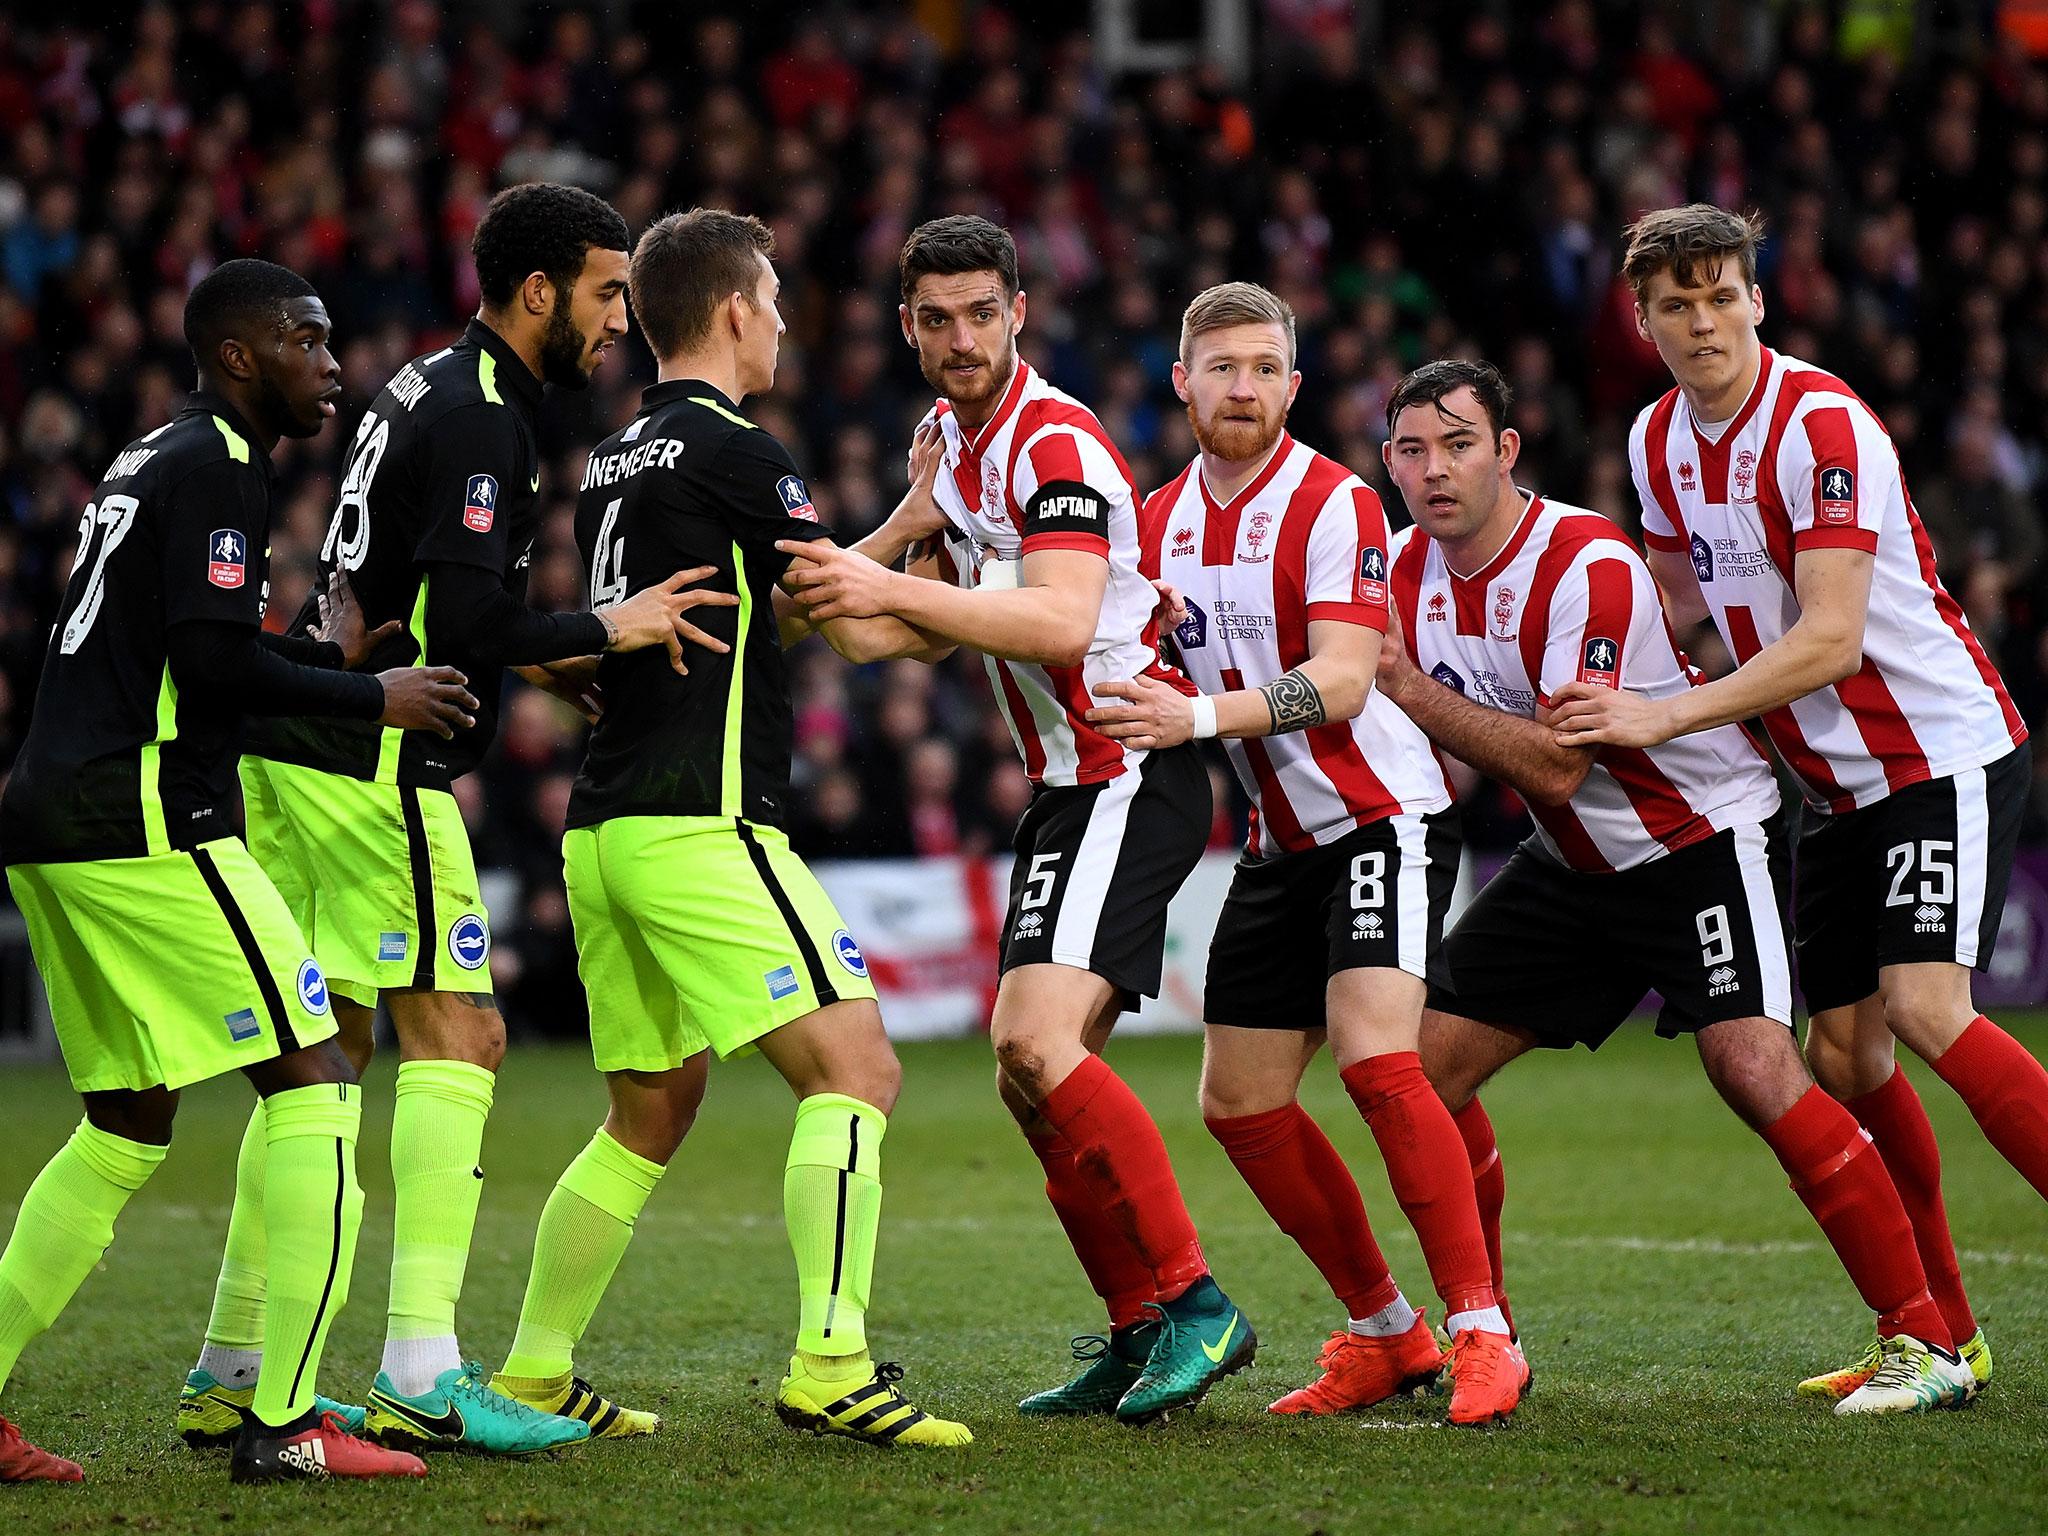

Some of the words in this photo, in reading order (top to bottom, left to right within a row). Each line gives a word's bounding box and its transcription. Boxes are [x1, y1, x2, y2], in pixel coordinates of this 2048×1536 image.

[1038, 496, 1098, 520] CAPTAIN
[591, 497, 627, 613] 4
[1714, 539, 1739, 550] BISHP
[1718, 560, 1773, 577] UNIVERSITY
[1021, 852, 1062, 910] 5
[1350, 851, 1385, 909] 8
[1886, 840, 1954, 908] 25
[1014, 928, 1042, 940] errea
[1352, 930, 1384, 940] errea
[1696, 904, 1734, 967] 9
[1914, 922, 1946, 933] errea
[1709, 982, 1740, 997] errea
[278, 1450, 330, 1482] adidas
